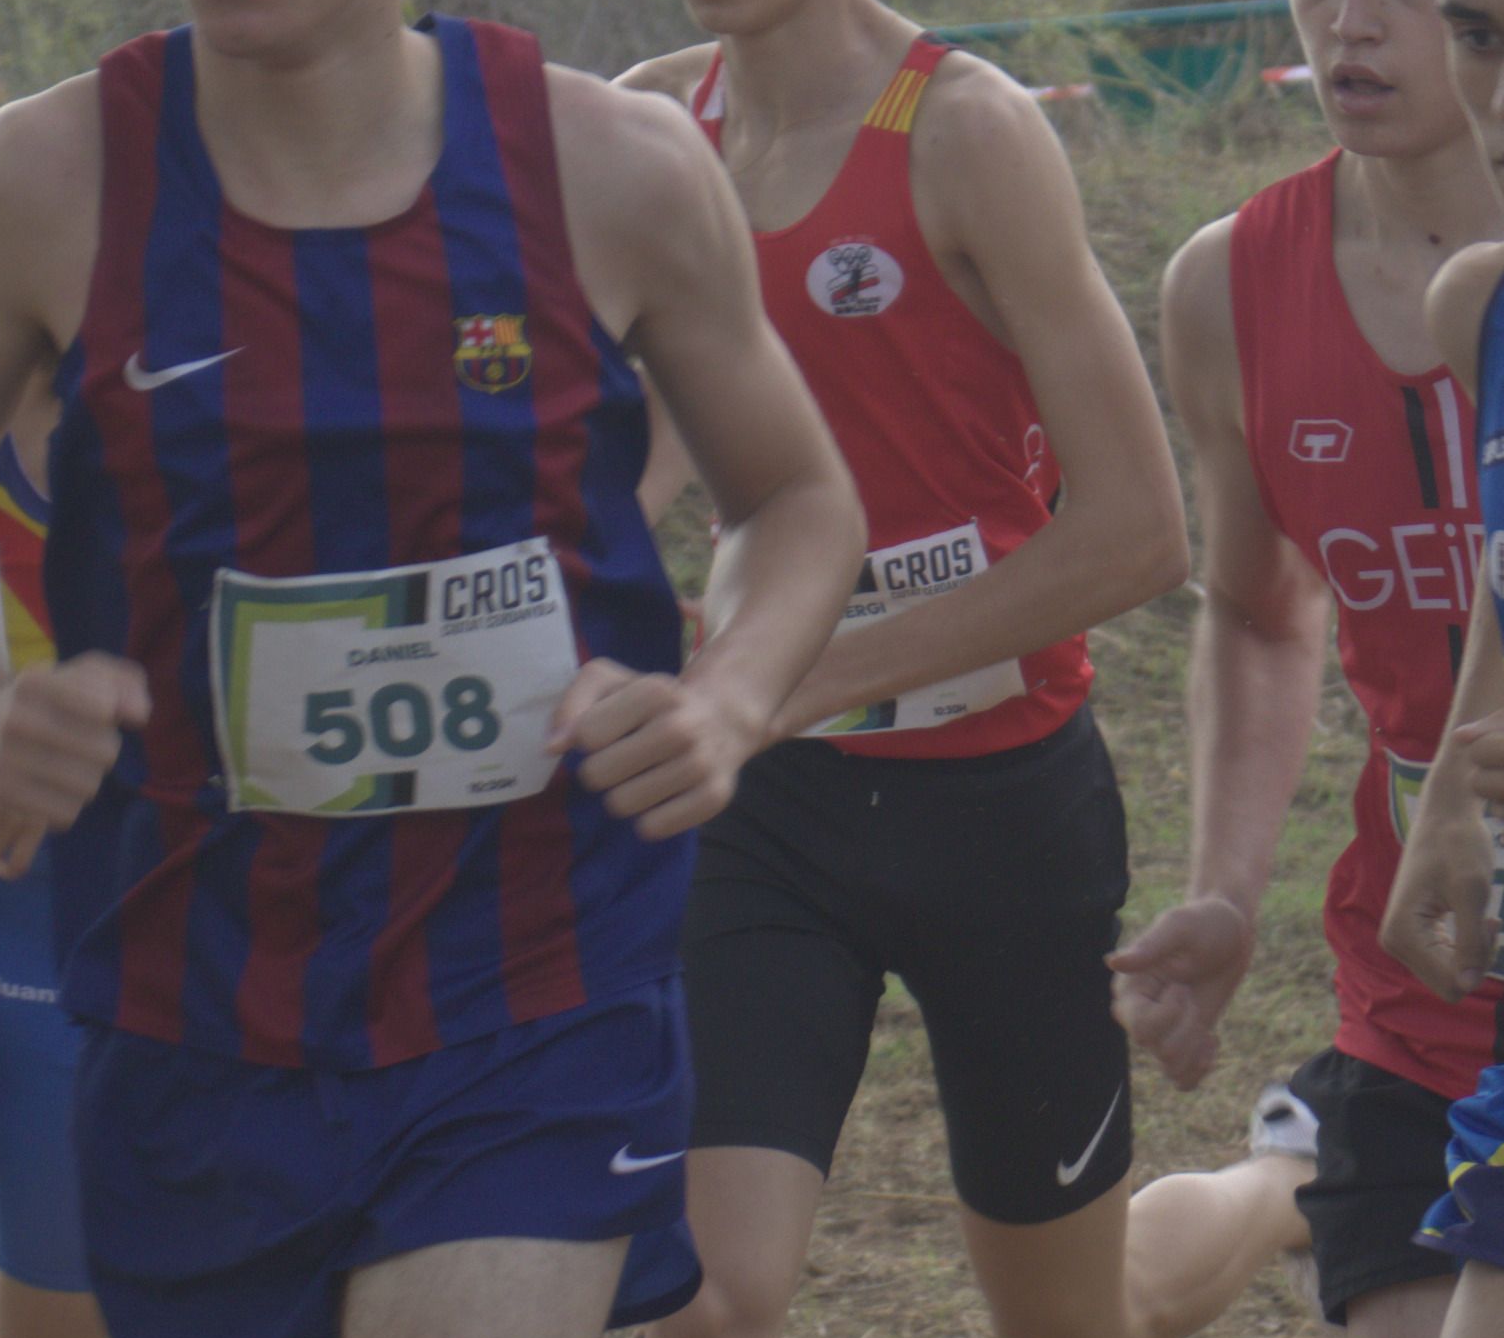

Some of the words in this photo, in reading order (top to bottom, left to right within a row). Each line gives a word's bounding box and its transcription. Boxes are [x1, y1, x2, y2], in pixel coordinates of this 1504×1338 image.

[443, 555, 547, 621] CROS
[885, 538, 973, 590] CROS
[845, 601, 887, 619] ERGI
[348, 641, 439, 666] DANIEL
[304, 675, 502, 766] 508
